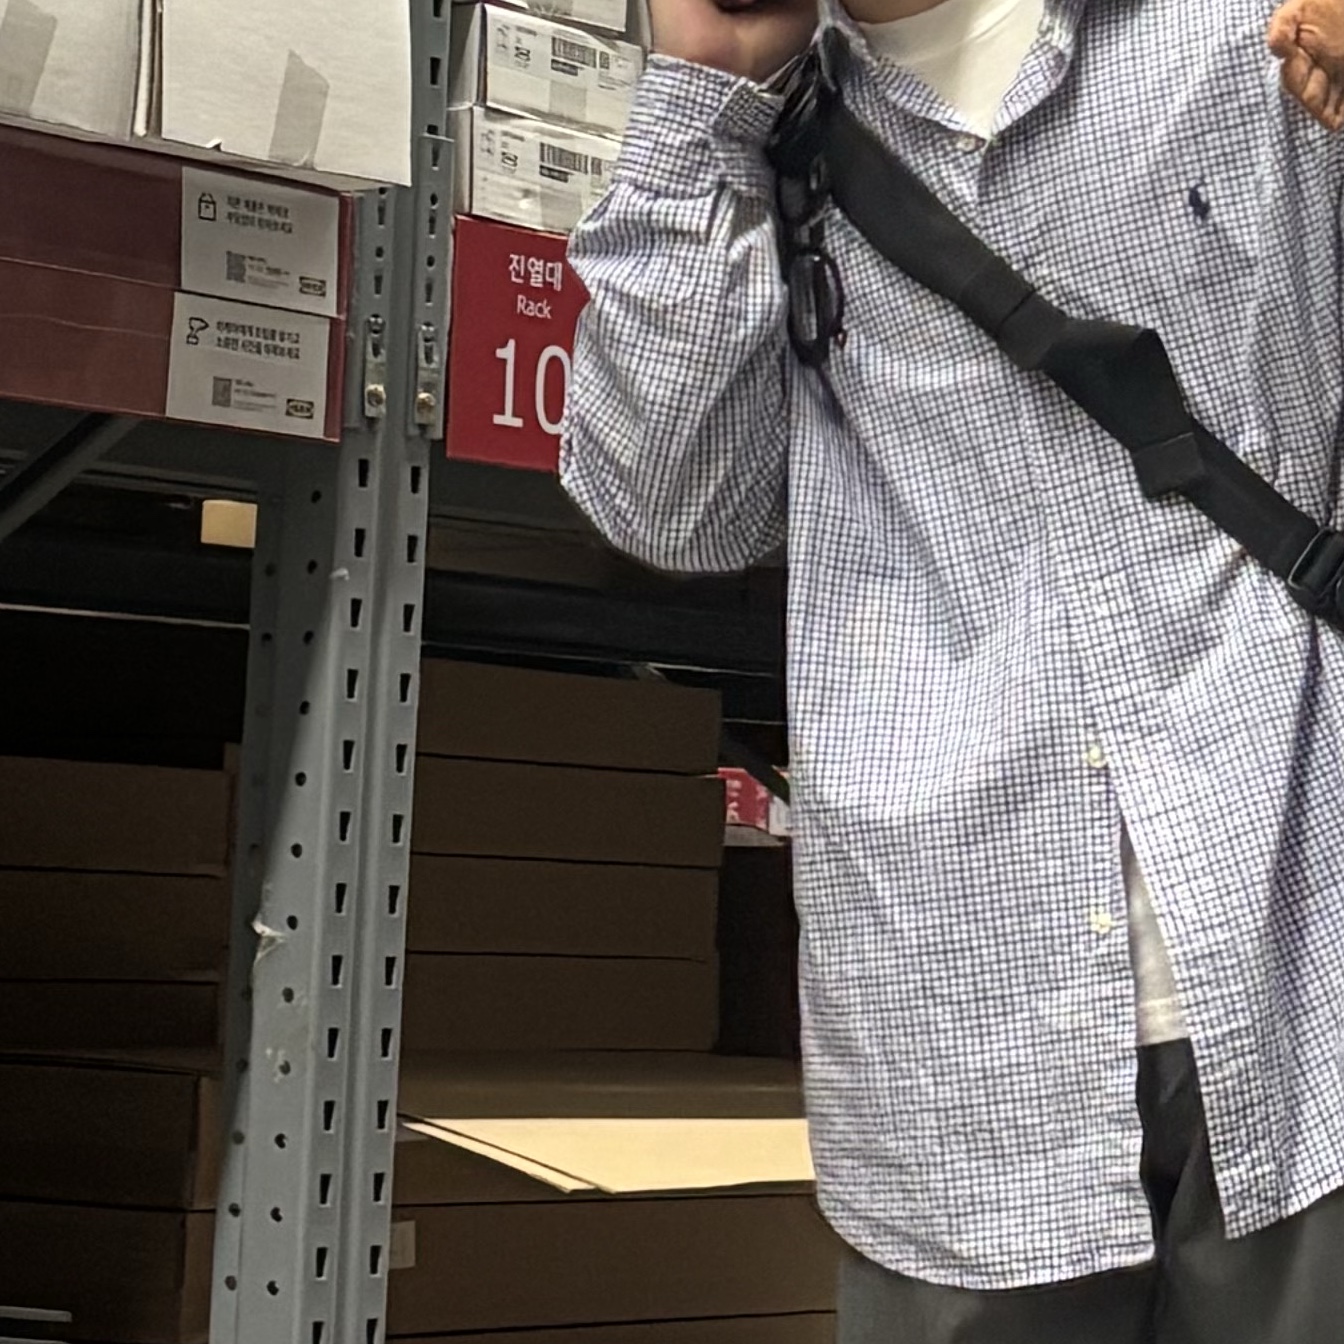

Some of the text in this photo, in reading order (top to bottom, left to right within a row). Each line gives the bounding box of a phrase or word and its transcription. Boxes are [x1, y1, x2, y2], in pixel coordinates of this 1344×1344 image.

[508, 254, 563, 292] 진열대
[516, 294, 552, 319] Rack
[492, 338, 573, 435] 10
